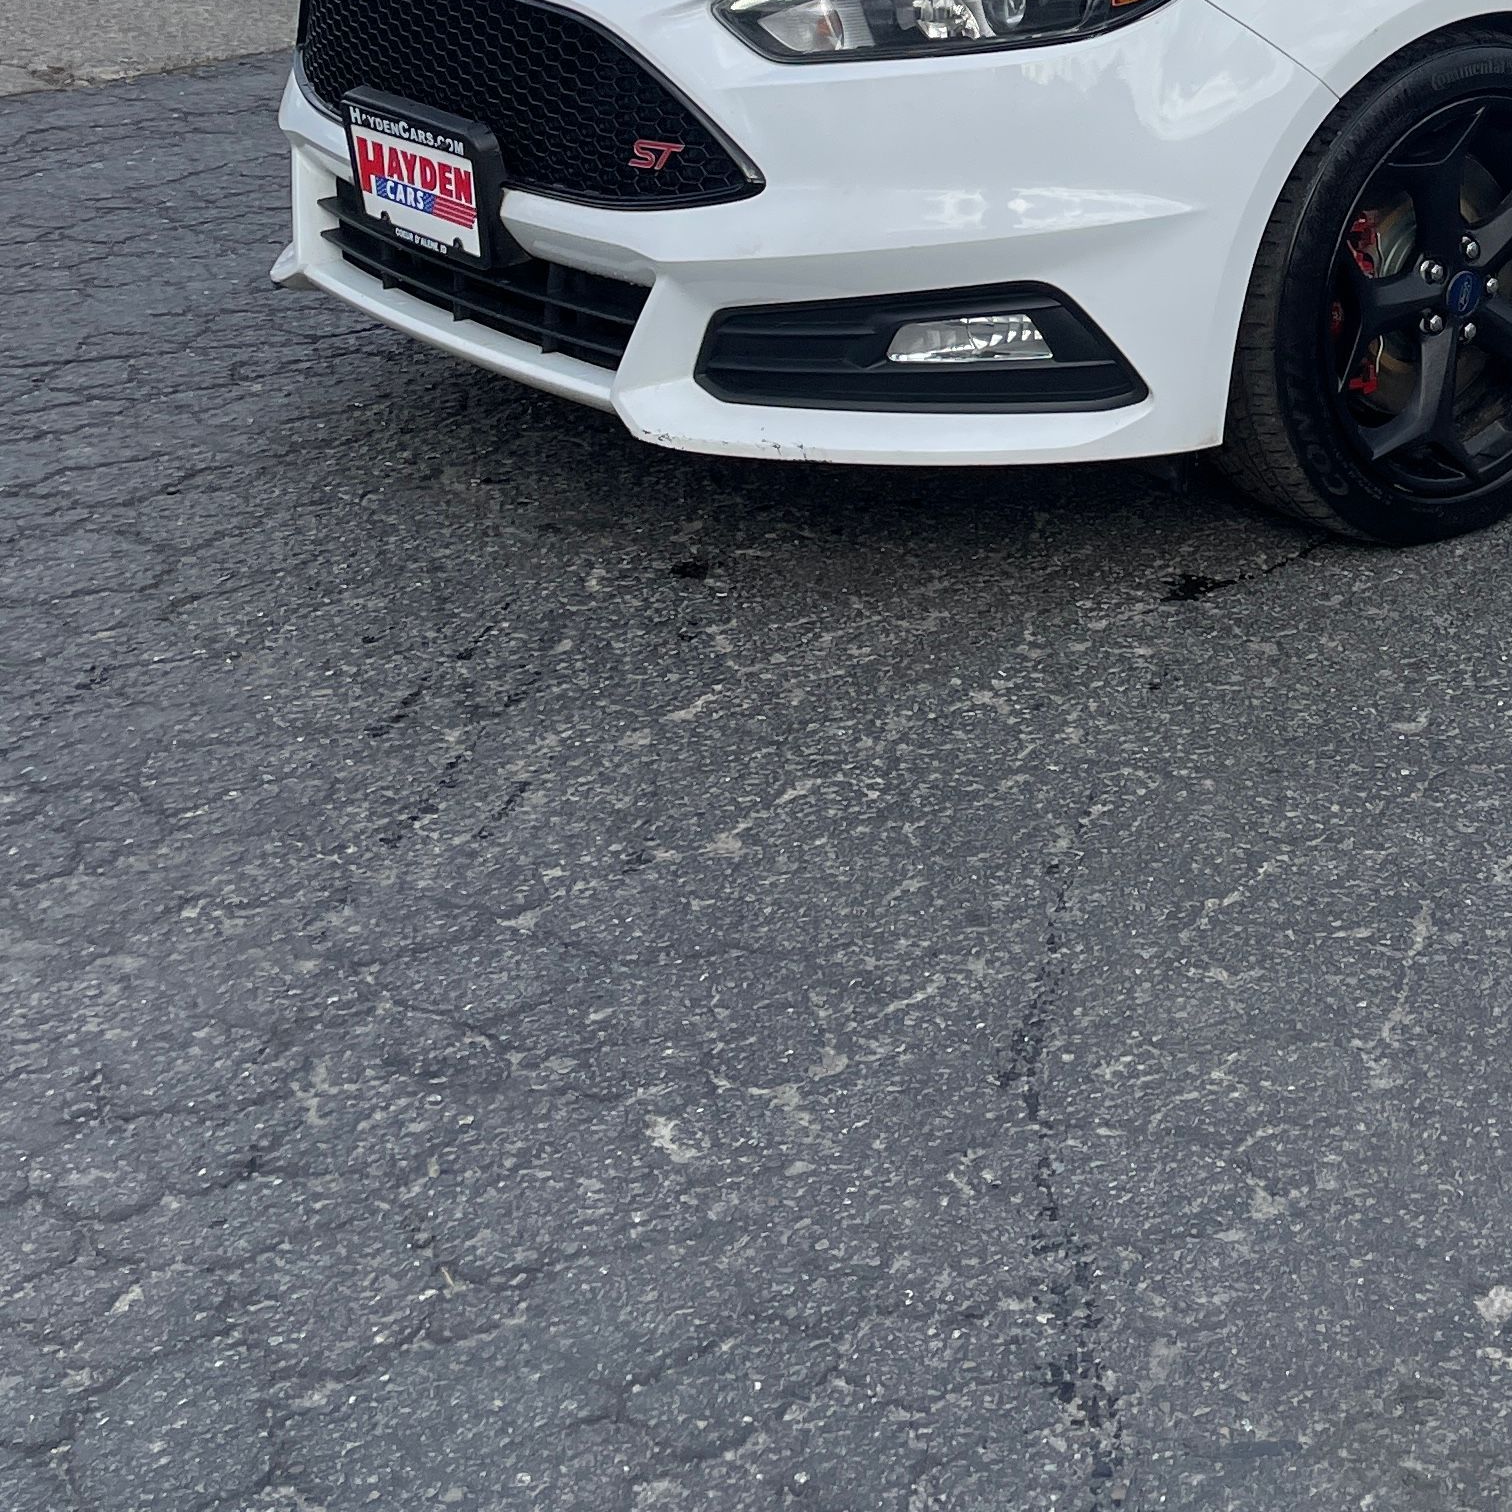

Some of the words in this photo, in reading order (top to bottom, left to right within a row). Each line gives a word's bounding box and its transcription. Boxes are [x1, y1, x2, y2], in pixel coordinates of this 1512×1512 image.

[628, 139, 685, 170] ST
[356, 136, 472, 205] HAYDEN
[386, 181, 424, 210] CARS
